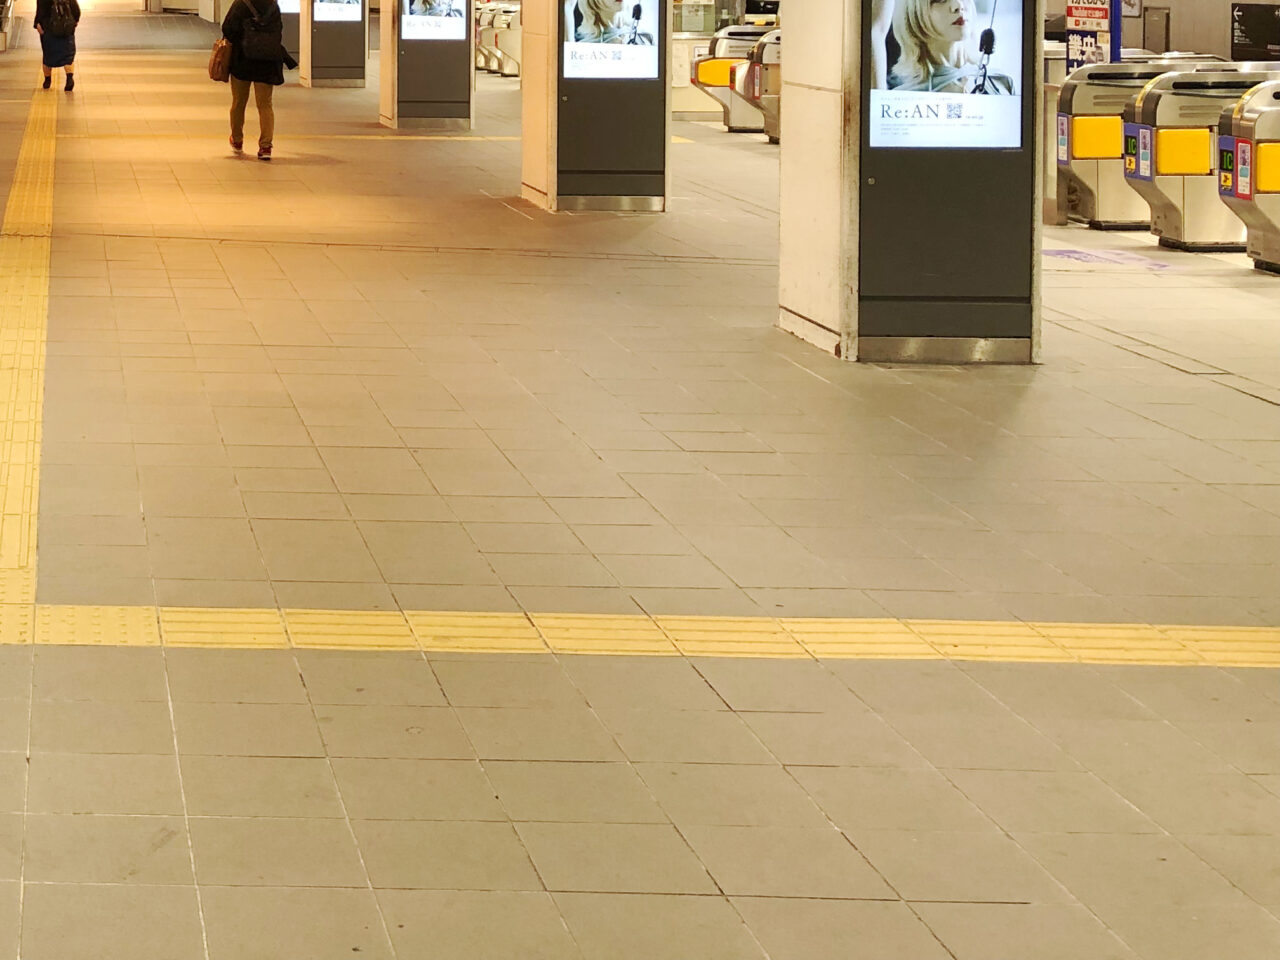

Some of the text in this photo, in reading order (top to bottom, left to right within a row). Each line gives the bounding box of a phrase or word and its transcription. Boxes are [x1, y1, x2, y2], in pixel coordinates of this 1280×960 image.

[570, 50, 608, 61] Re:AN
[880, 103, 941, 120] Re:AN
[1128, 138, 1137, 154] IC
[1222, 152, 1233, 169] IC
